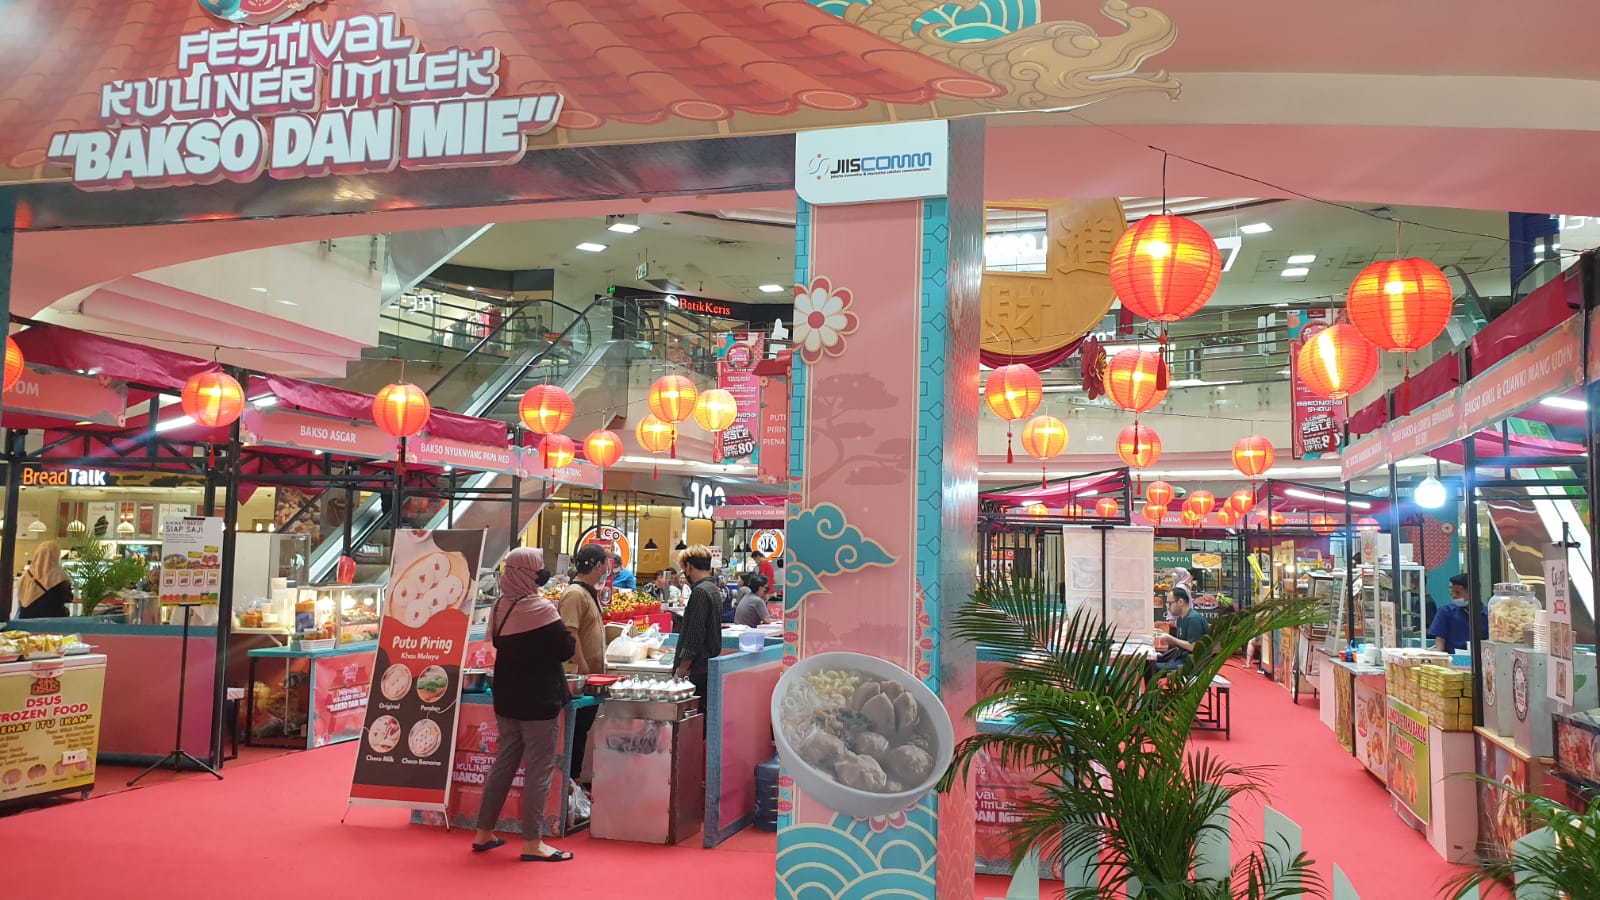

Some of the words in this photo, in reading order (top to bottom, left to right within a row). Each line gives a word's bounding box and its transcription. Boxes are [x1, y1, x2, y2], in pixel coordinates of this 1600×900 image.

[102, 66, 313, 118] KULINER
[332, 48, 496, 101] IMLEK
[48, 117, 259, 182] "BAKSO
[273, 108, 393, 168] DAN
[408, 95, 560, 157] MIE"
[830, 152, 932, 174] JIISCOMM
[1464, 395, 1480, 417] BAKSO
[1528, 358, 1551, 383] MANG
[1552, 344, 1573, 371] UDIN
[300, 424, 328, 440] BAKSO
[421, 443, 444, 455] BAKSO
[165, 525, 184, 533] SIAP
[392, 636, 417, 649] Putu
[420, 637, 453, 654] Piring
[26, 695, 62, 708] DSUS
[53, 703, 88, 716] FOOD
[36, 719, 55, 730] ITU
